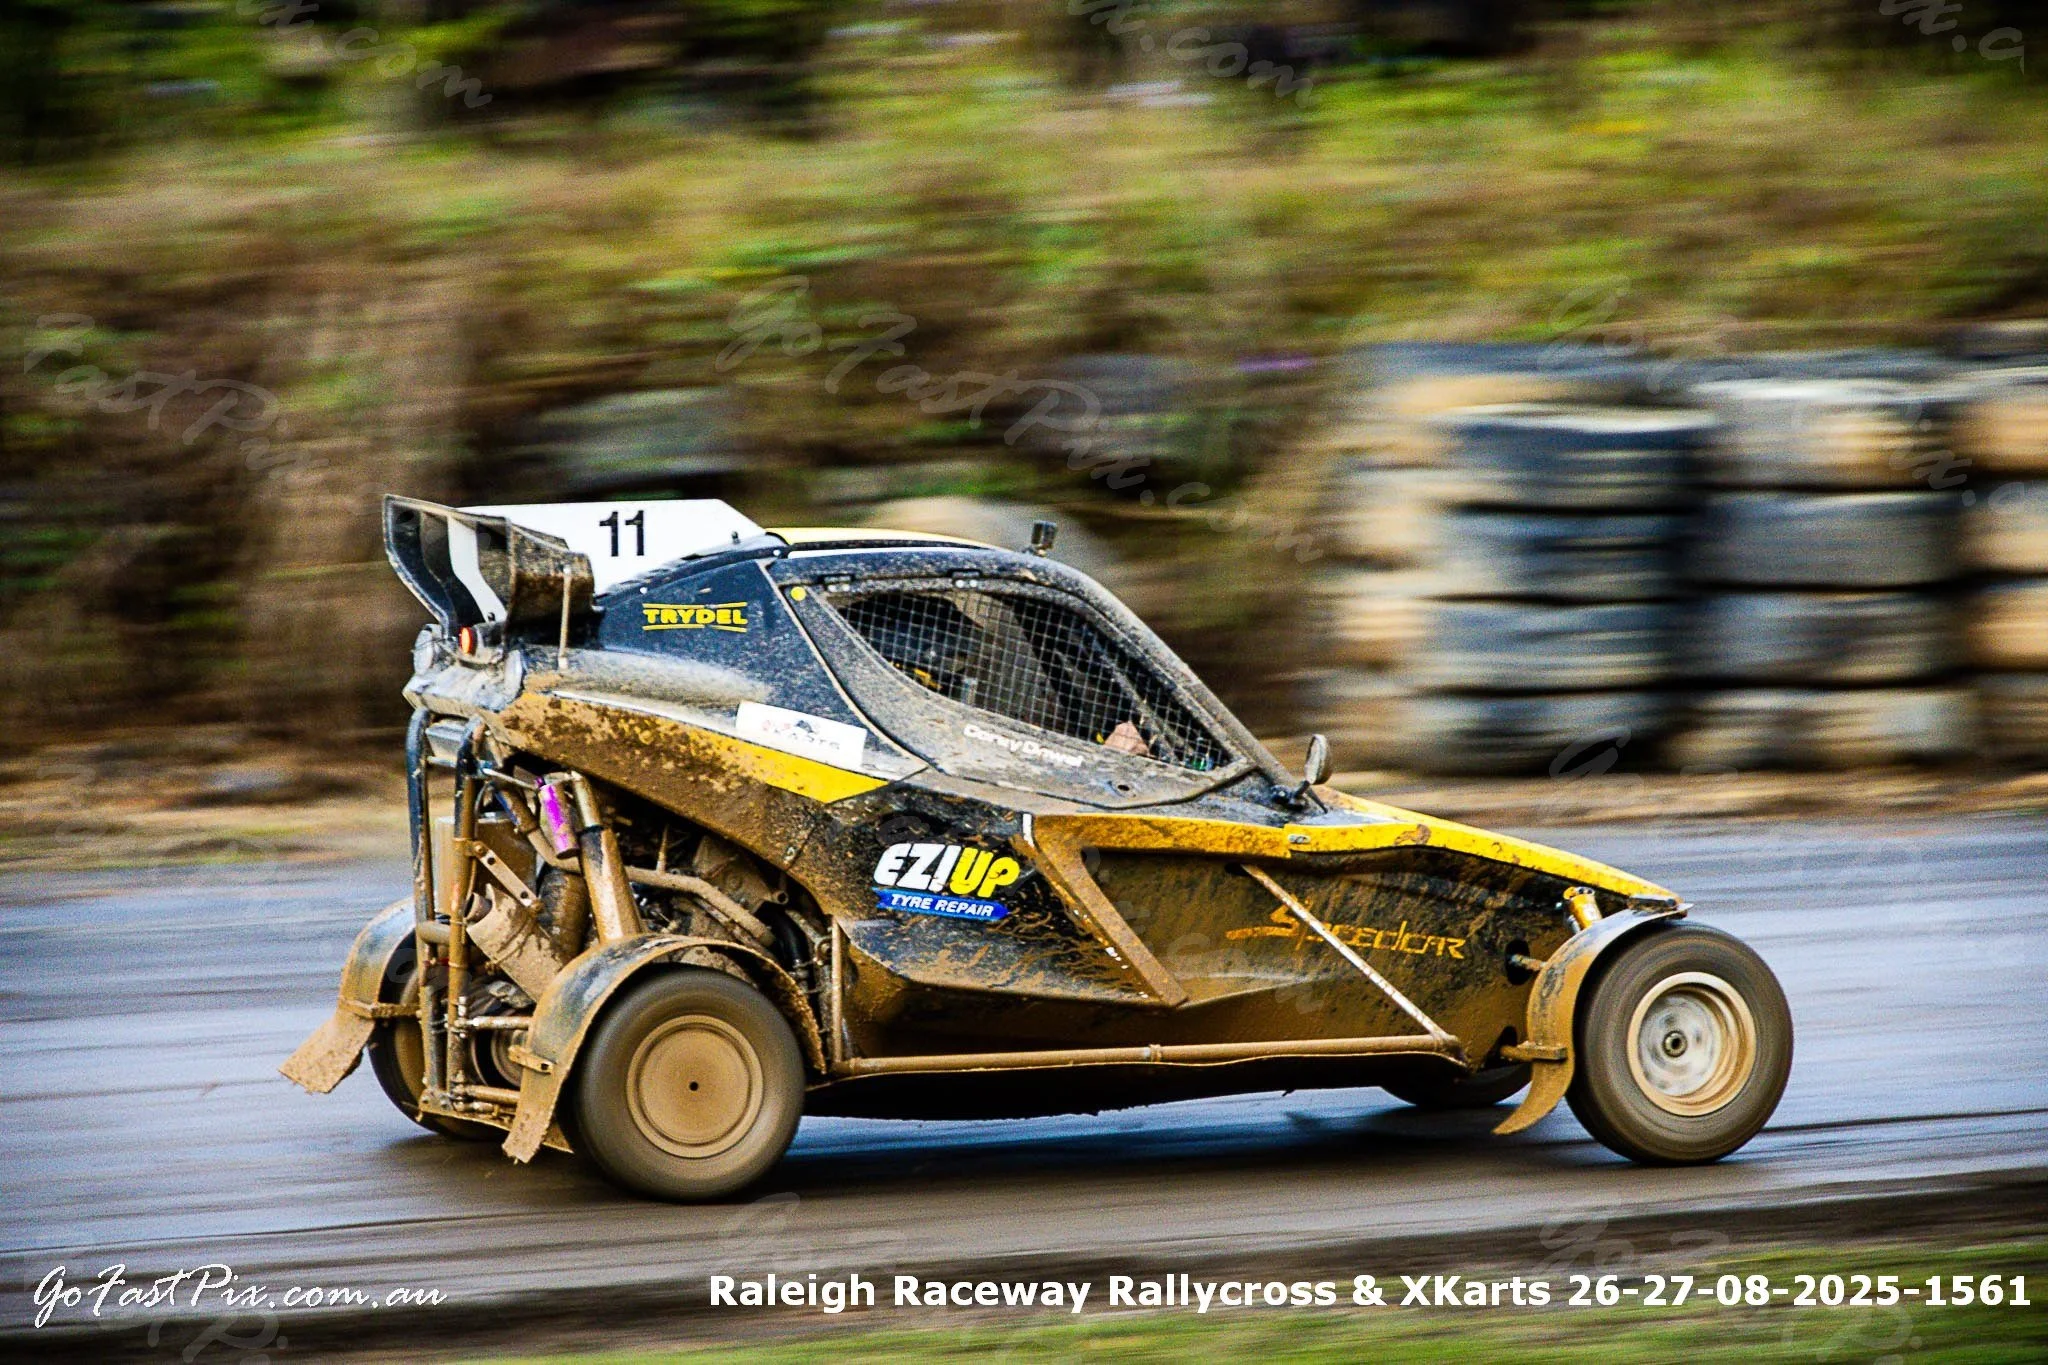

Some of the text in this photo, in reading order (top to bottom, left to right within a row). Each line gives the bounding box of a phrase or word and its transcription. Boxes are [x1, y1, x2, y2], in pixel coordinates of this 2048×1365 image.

[599, 510, 645, 557] 11
[643, 608, 748, 625] TRYDEL
[891, 893, 994, 917] TYRE REPAIR
